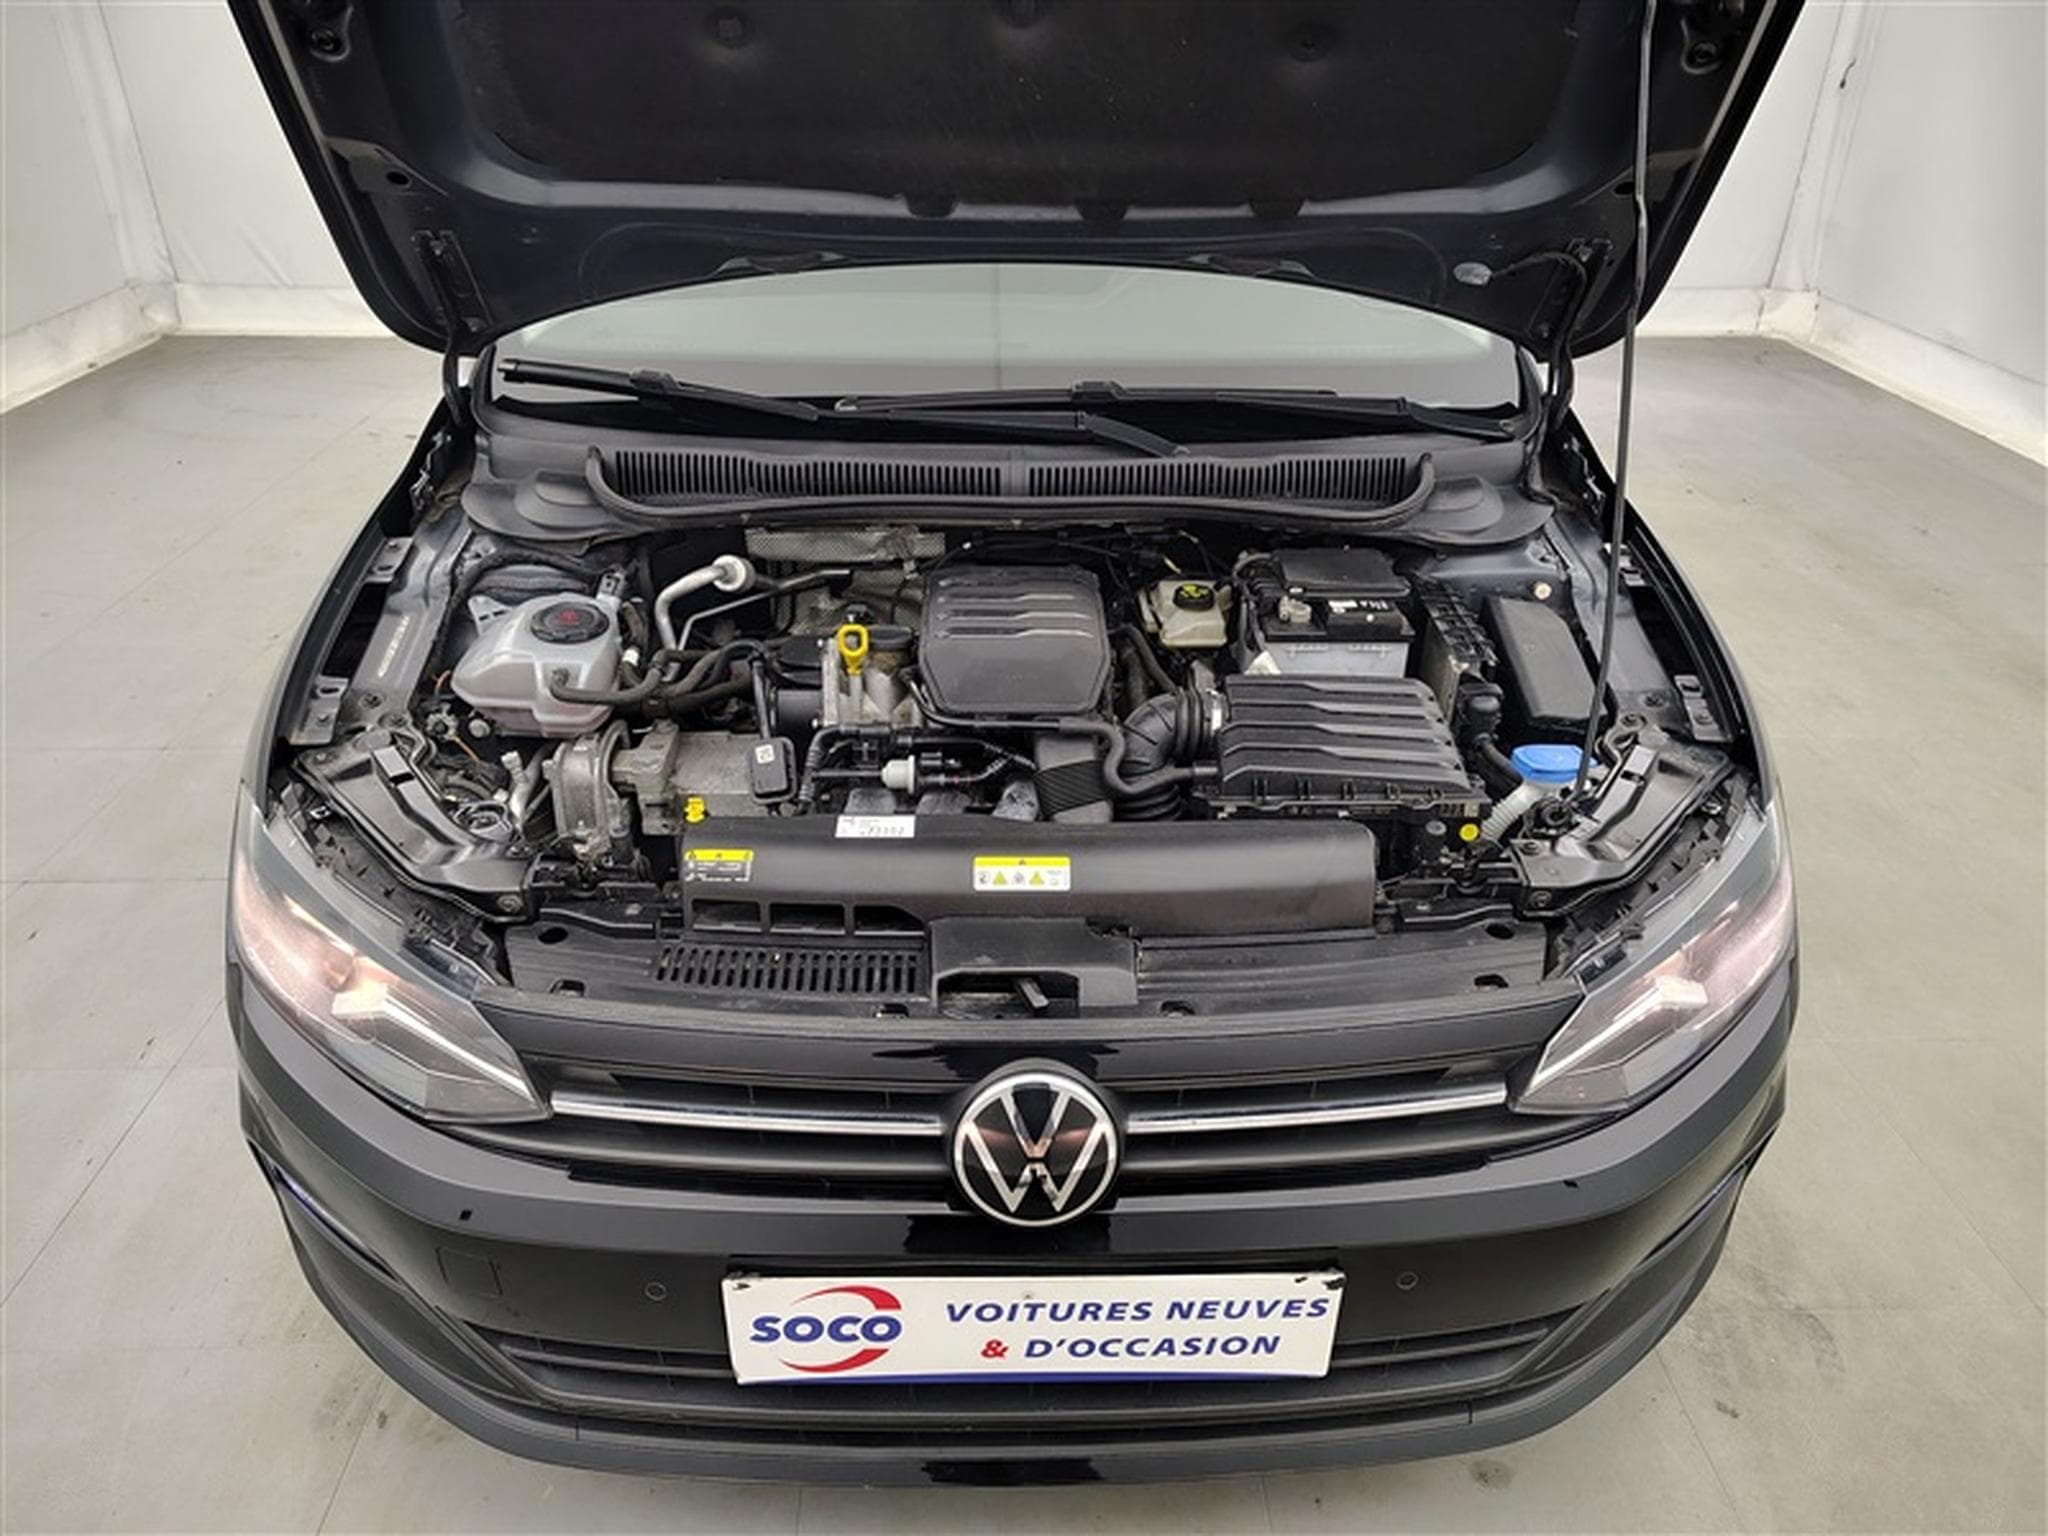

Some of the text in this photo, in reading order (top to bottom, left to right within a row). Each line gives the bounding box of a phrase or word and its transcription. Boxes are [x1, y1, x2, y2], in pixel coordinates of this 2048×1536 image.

[947, 1298, 1329, 1322] VOITURES NEUVES
[750, 1315, 902, 1343] SOCO
[980, 1335, 1281, 1359] & D'OCCASION
